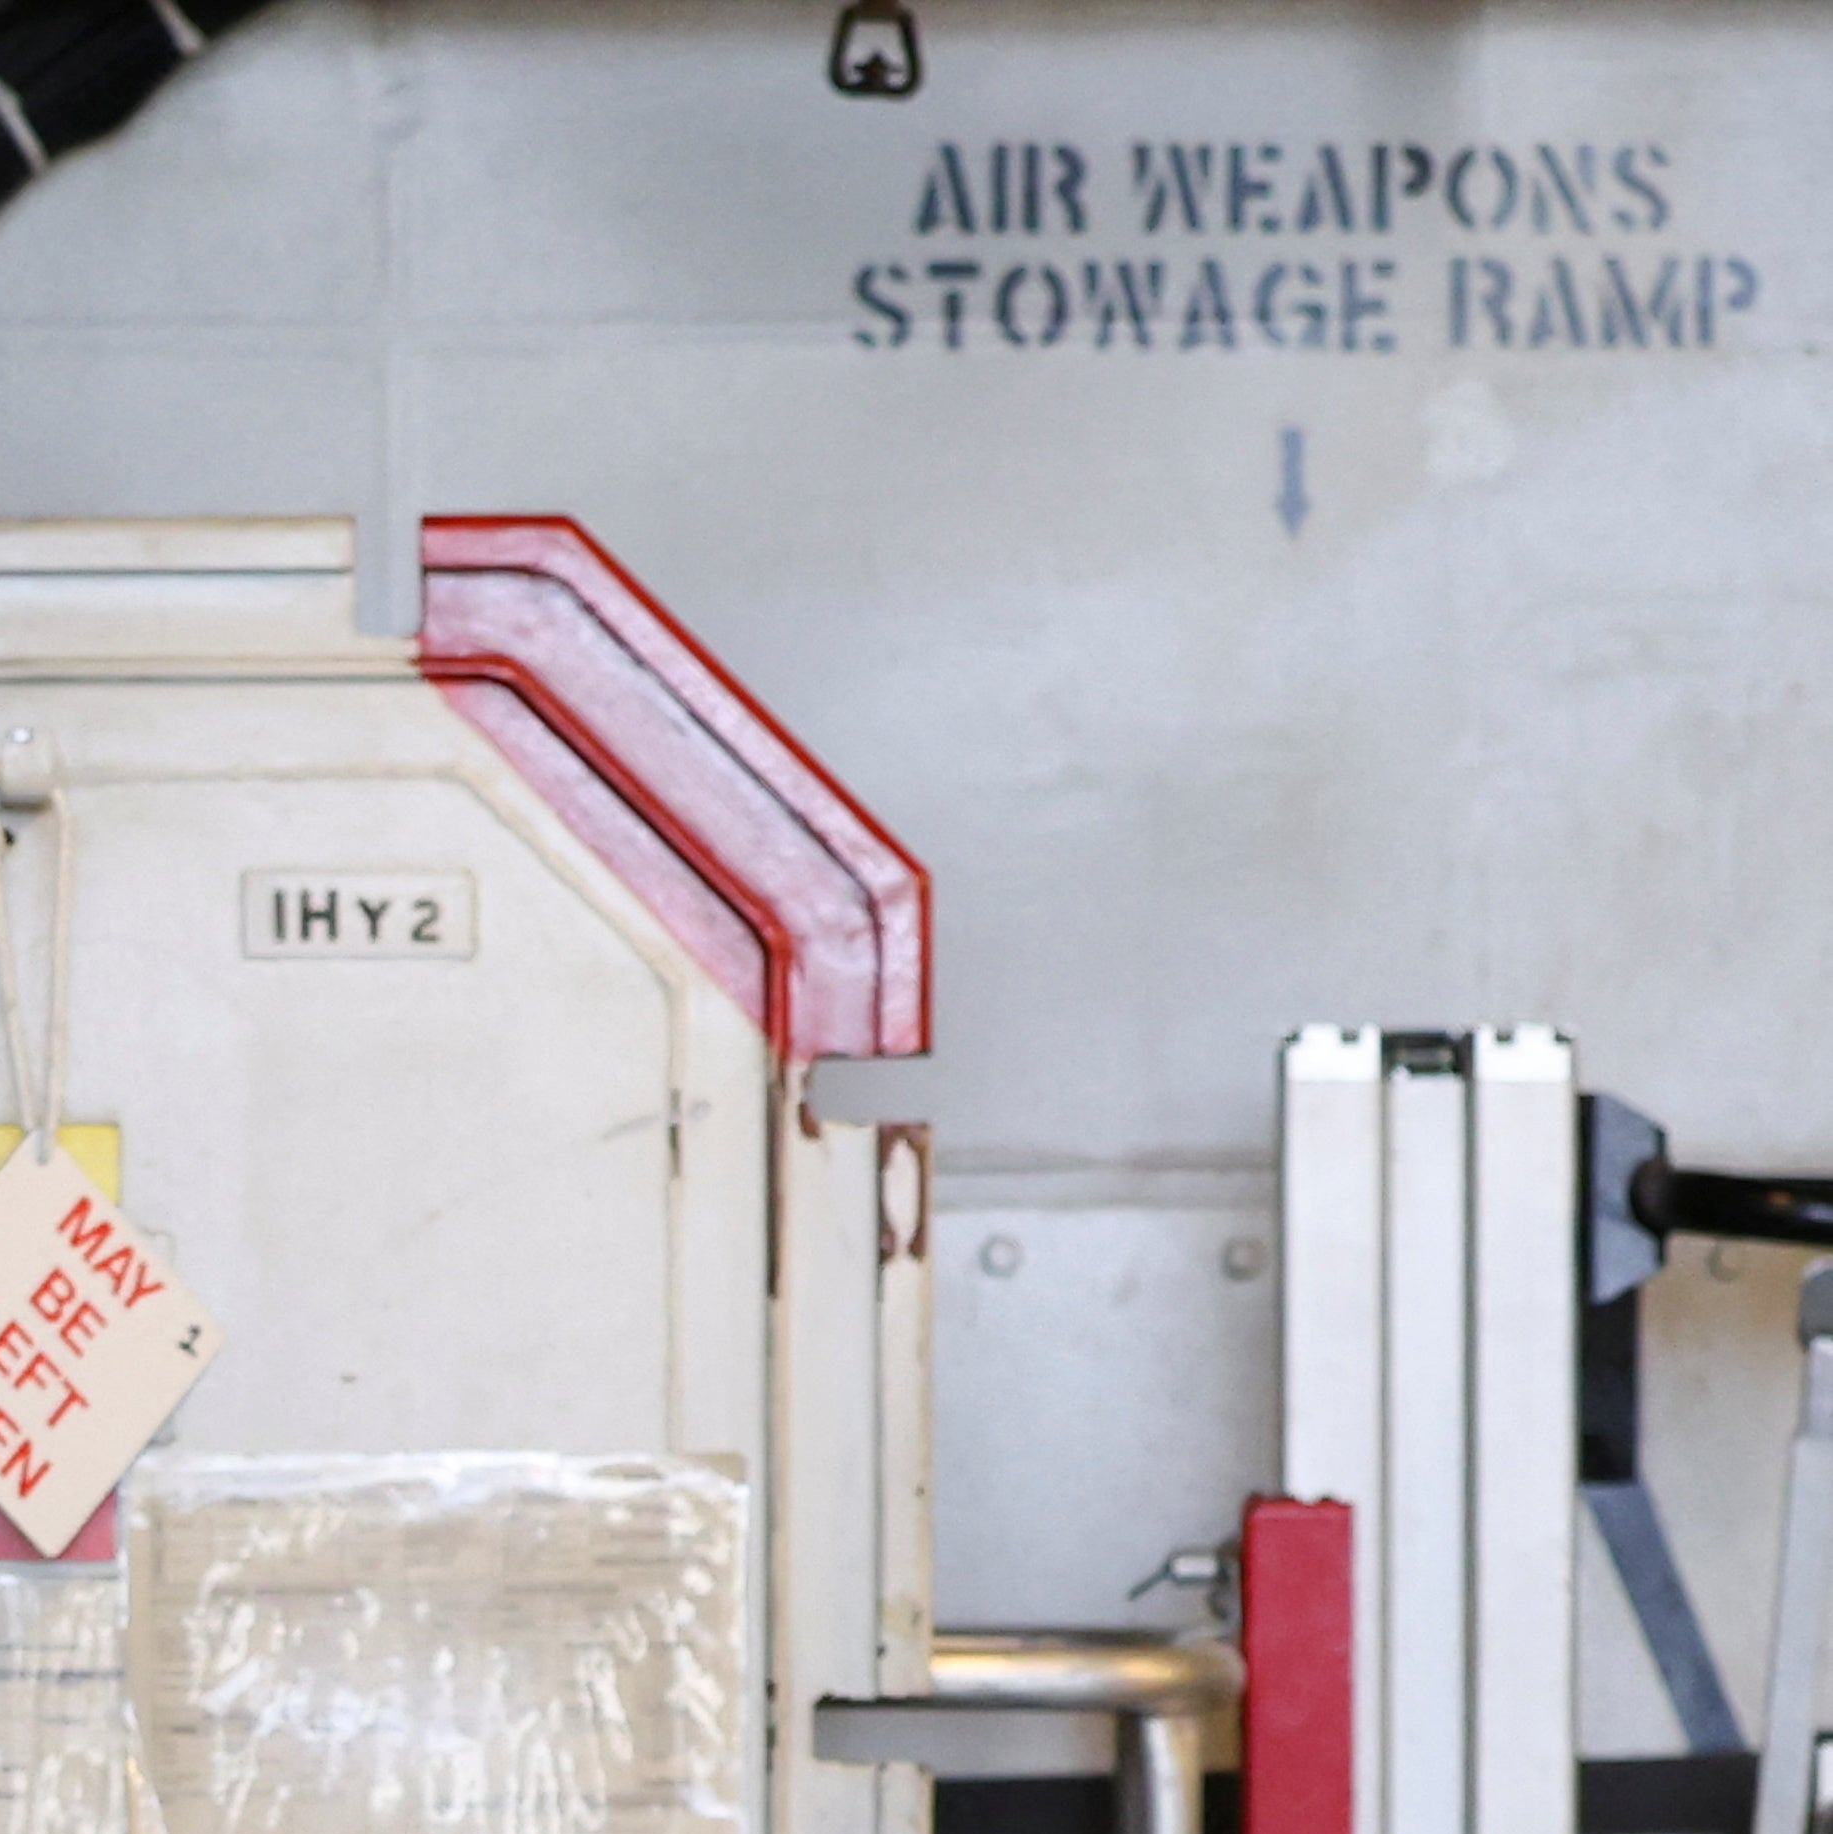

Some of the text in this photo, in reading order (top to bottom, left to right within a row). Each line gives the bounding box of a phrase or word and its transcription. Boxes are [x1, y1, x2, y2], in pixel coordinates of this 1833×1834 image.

[915, 142, 1671, 235] AIR WEAPONS
[850, 257, 1759, 352] STOWAGE RAMP
[57, 1196, 165, 1311] MAY
[29, 1268, 109, 1357] BE
